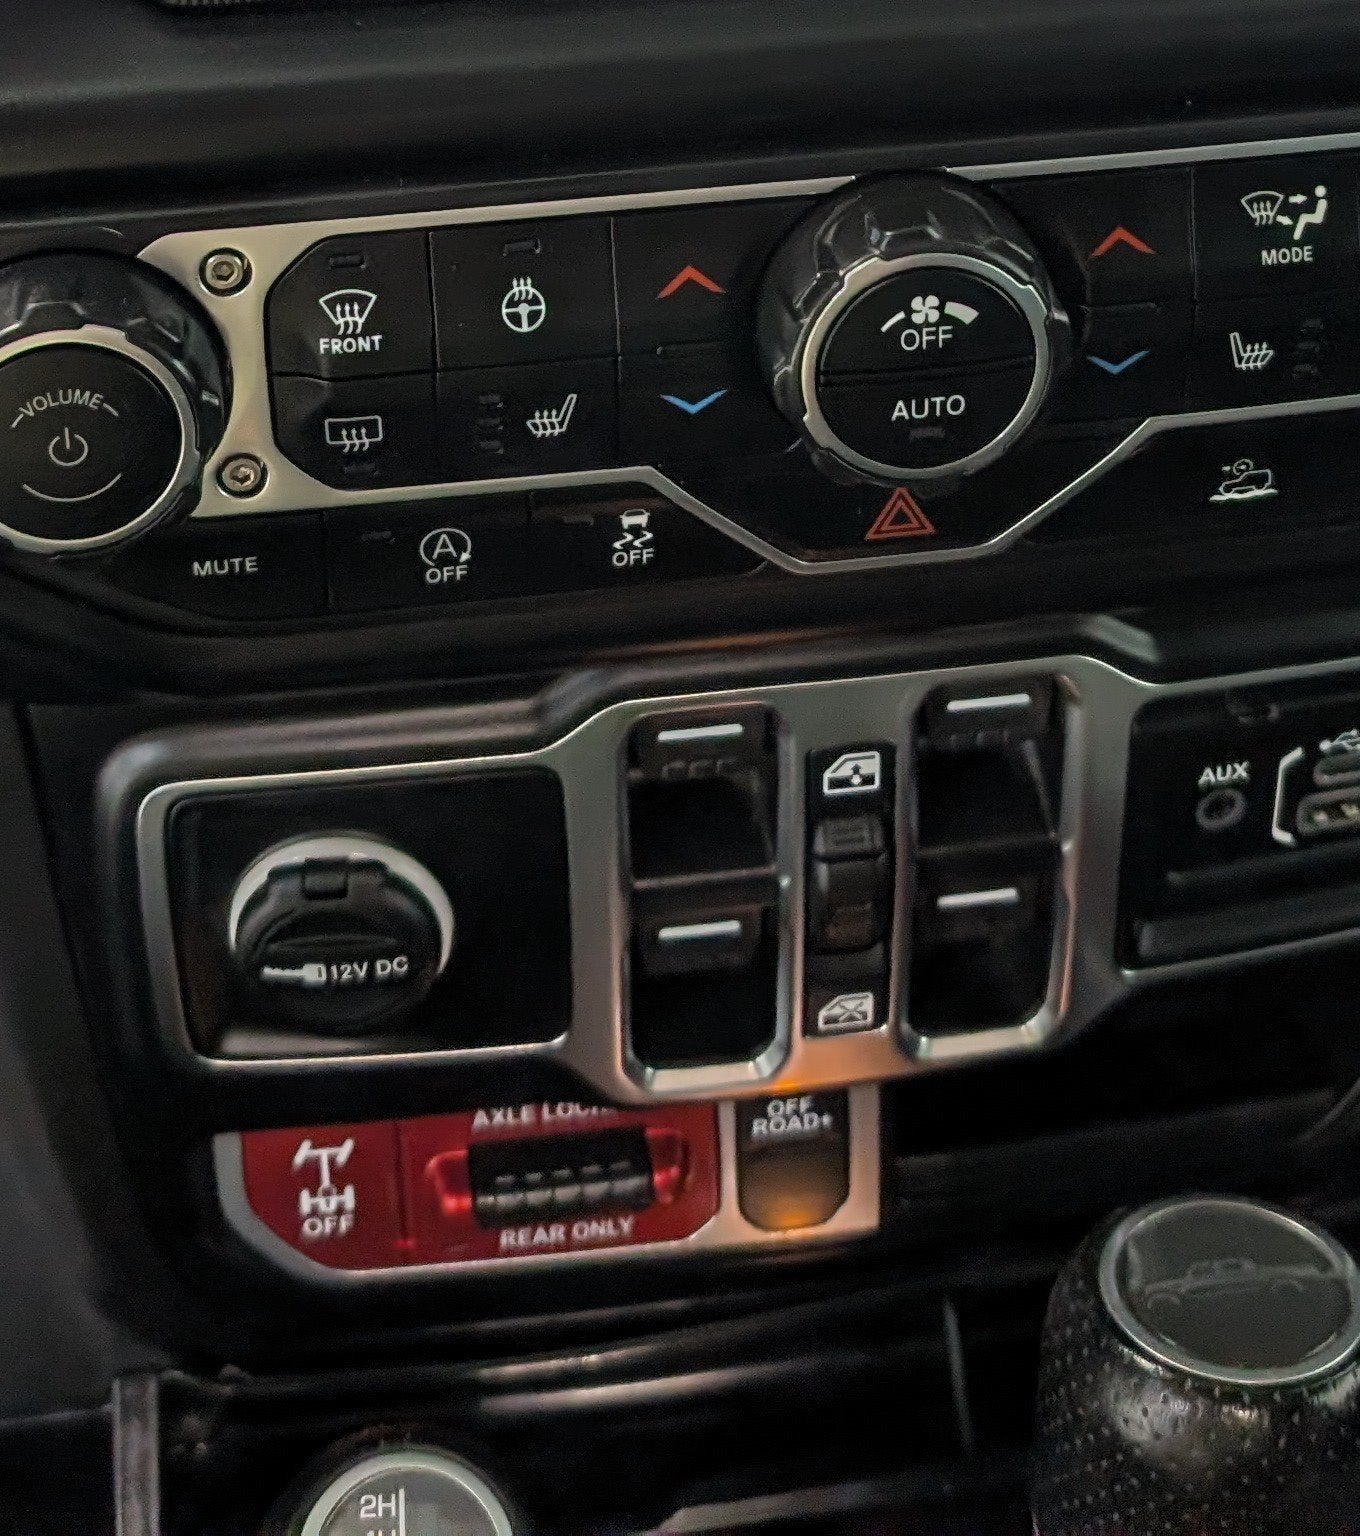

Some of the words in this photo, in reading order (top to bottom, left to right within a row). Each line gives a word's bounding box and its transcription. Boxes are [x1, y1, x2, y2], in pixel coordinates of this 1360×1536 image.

[1261, 246, 1313, 265] MODE
[320, 335, 382, 354] FRONT
[900, 326, 953, 351] OFF
[20, 389, 103, 418] VOLUME
[891, 395, 966, 421] AUTO
[192, 557, 258, 577] MUTE
[612, 548, 654, 567] OFF
[425, 565, 469, 584] OFF
[1198, 761, 1248, 786] AUX
[330, 961, 368, 984] 12V
[376, 955, 409, 977] DC
[471, 1104, 536, 1132] AXLE
[767, 1096, 812, 1117] OFF
[302, 1209, 353, 1237] OFF
[499, 1223, 565, 1252] REAR
[572, 1216, 634, 1244] ONLY
[360, 1494, 396, 1517] 2H
